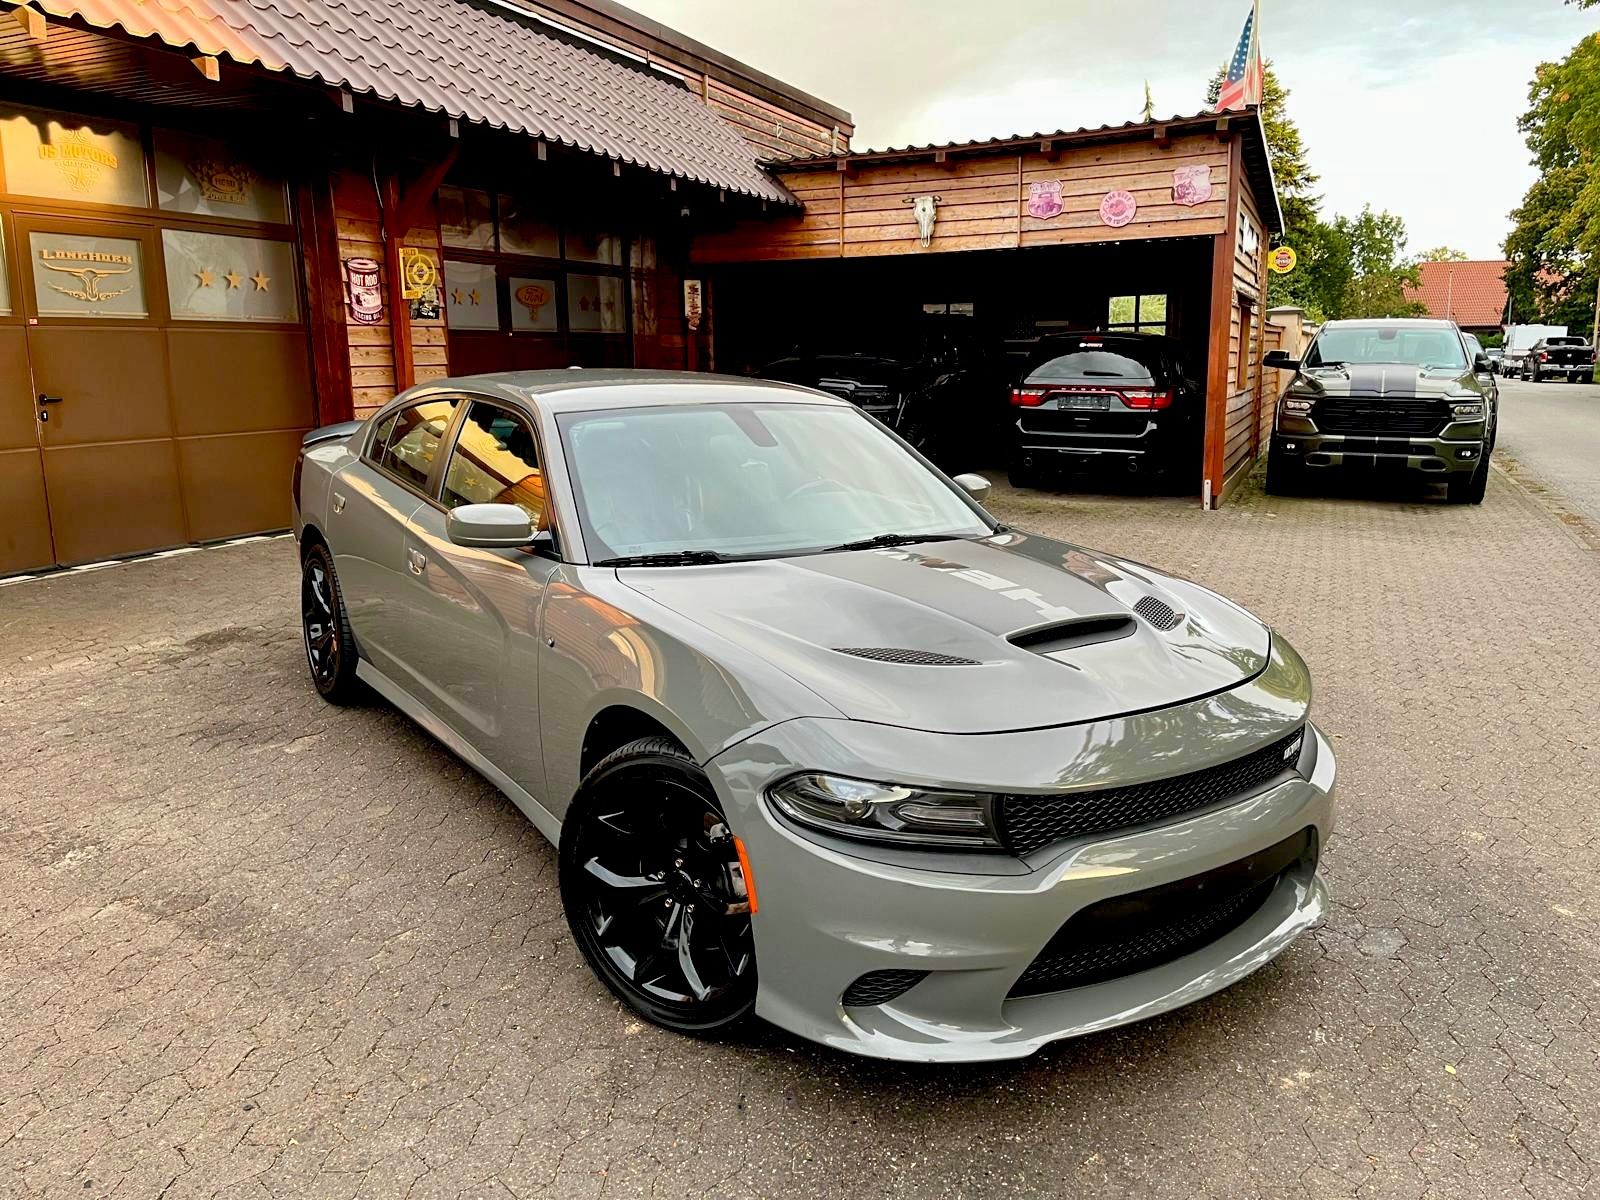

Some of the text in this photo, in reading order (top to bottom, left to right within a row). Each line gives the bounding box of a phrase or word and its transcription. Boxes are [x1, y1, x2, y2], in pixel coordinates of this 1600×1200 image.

[62, 143, 118, 169] MOTORS
[42, 248, 132, 265] LONGHORN
[351, 273, 378, 287] HOT ROD
